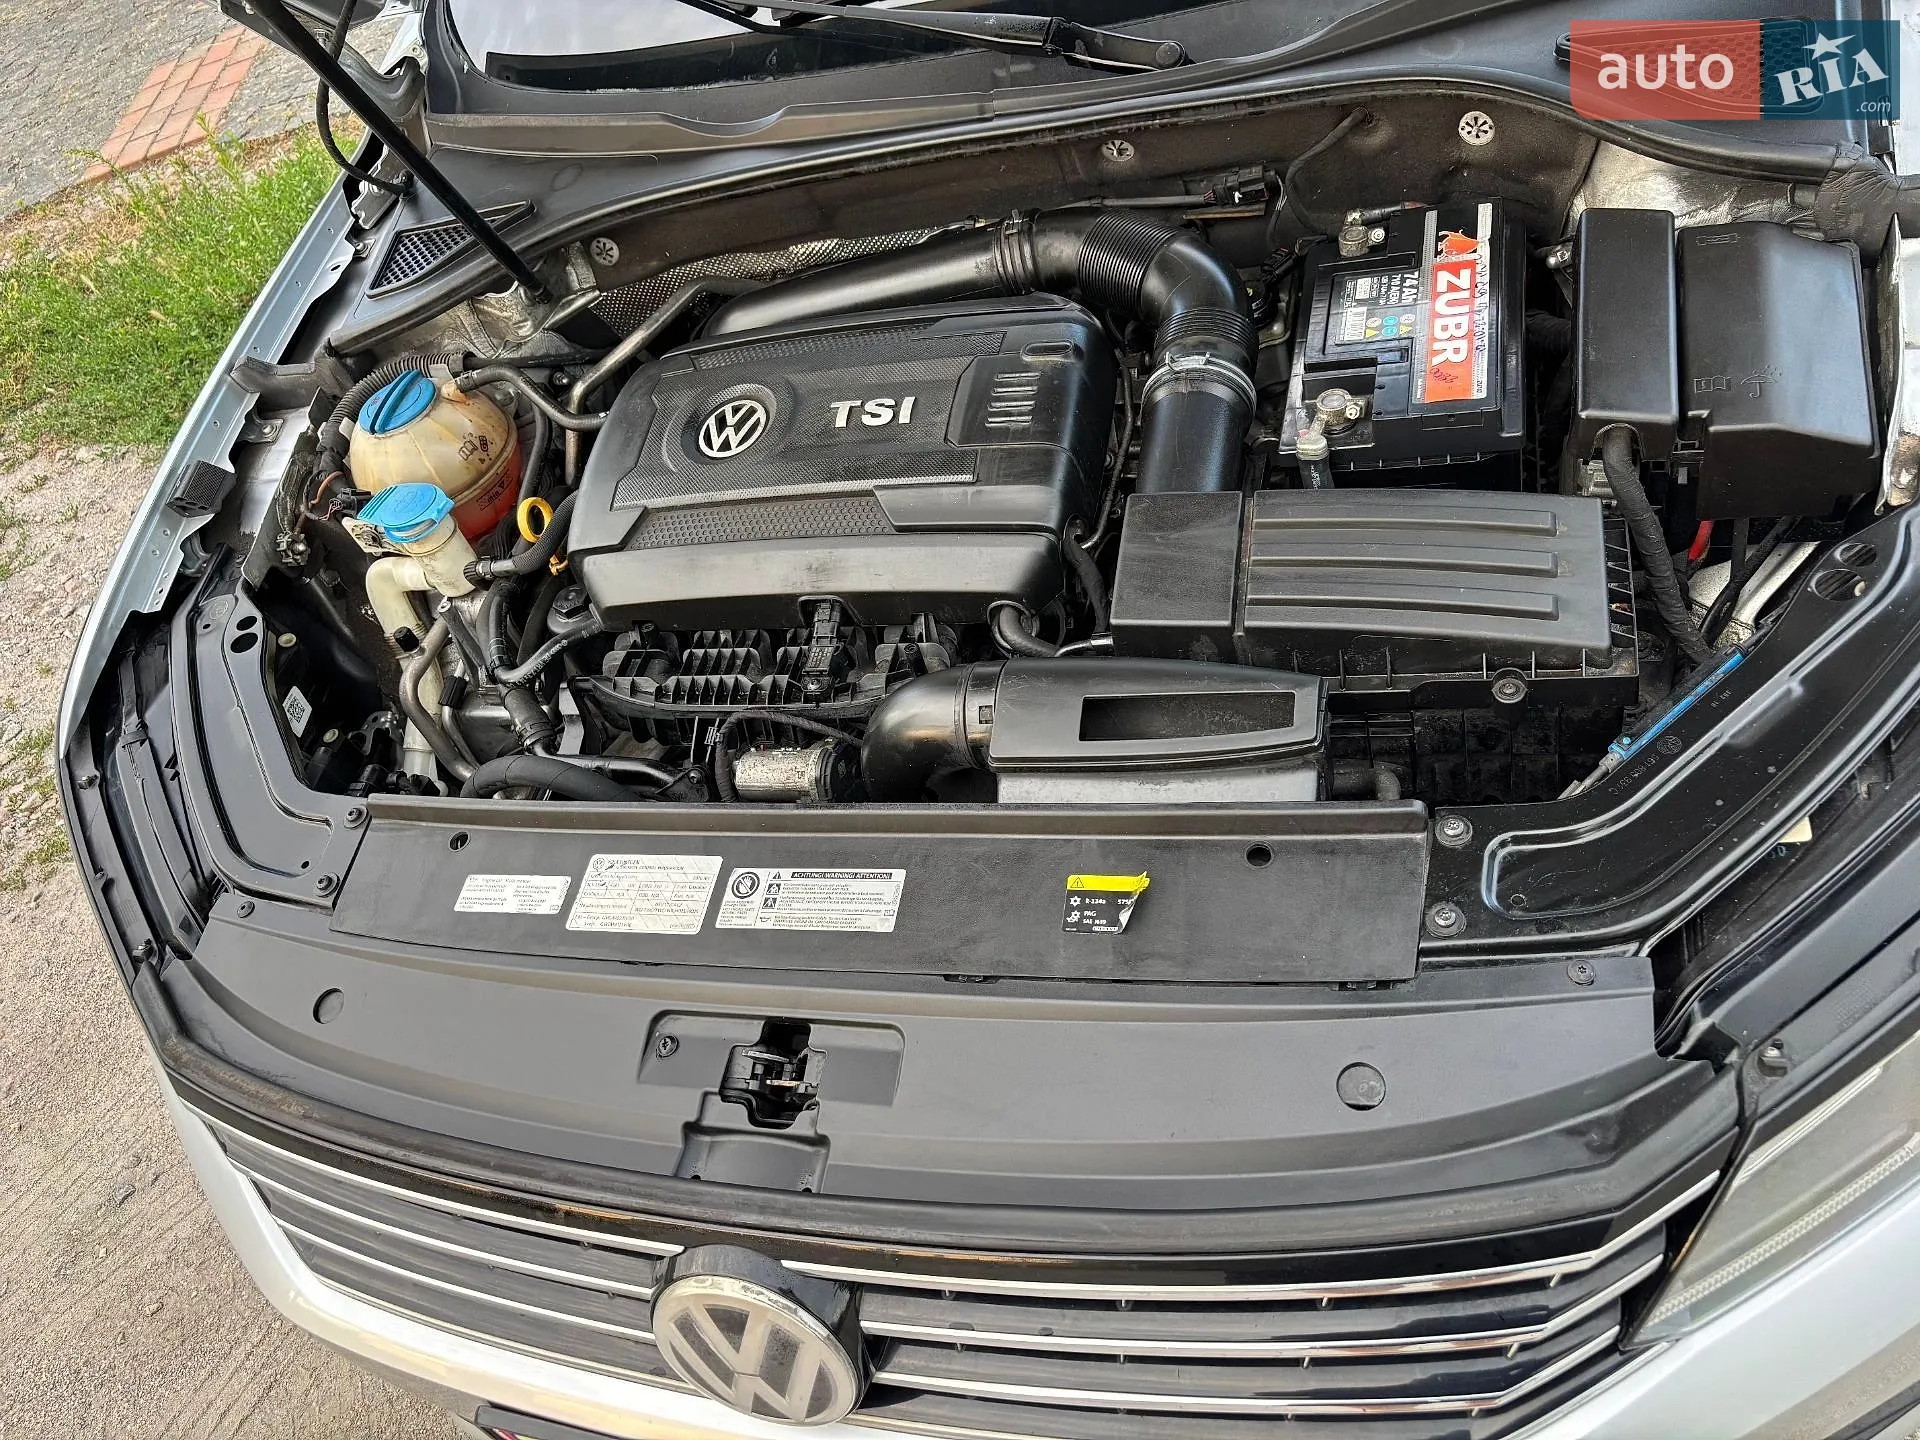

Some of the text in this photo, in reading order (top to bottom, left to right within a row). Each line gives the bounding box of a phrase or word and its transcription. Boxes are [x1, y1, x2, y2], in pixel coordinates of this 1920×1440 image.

[1403, 271, 1419, 287] 74
[1431, 268, 1472, 367] ZUBR
[830, 396, 916, 428] TSI
